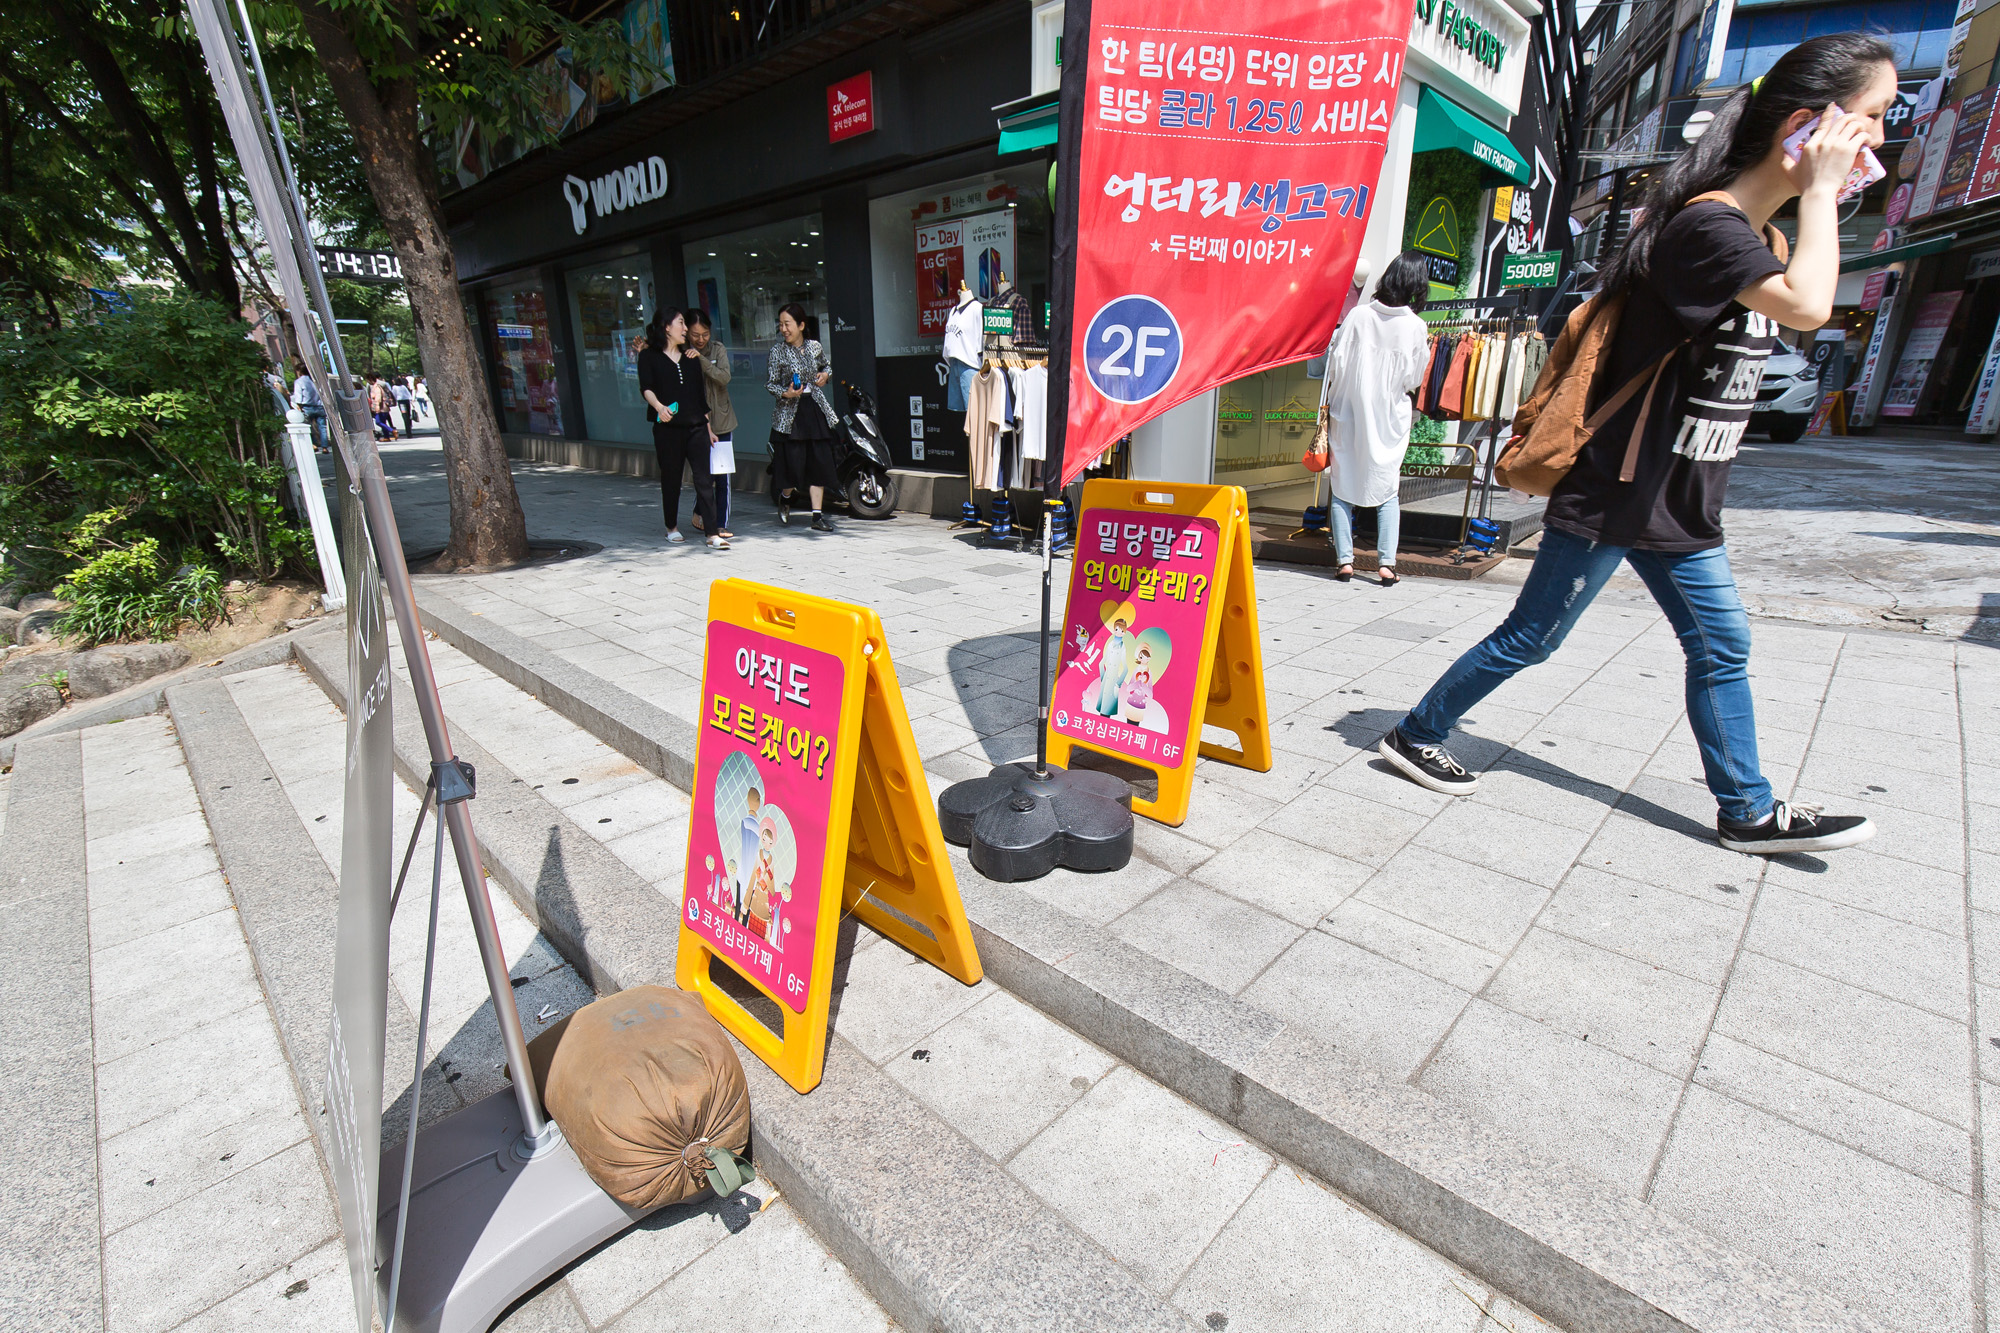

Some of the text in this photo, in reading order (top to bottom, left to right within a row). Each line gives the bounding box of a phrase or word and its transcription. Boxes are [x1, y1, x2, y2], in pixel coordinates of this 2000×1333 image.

[1441, 1, 1507, 73] FACTORY
[1101, 37, 1400, 91] 한 팀(4명) 단위 입장 시
[833, 98, 866, 117] SK telecom
[1099, 86, 1151, 125] 팀당
[1158, 88, 1217, 130] 콜라
[1311, 98, 1388, 134] 서비스
[1473, 139, 1518, 176] LUCKY FACTORY
[590, 156, 668, 217] WORLD
[923, 257, 935, 269] LG
[1167, 234, 1295, 265] 두번째 이야기
[1506, 262, 1556, 280] 5900원
[984, 316, 1011, 328] 12000원
[1099, 324, 1170, 377] 2F
[1265, 411, 1318, 420] LUCKY FACTORY
[1400, 465, 1450, 477] ACTORY
[1097, 520, 1204, 560] 밀당말고
[1083, 559, 1207, 604] 연애할래?
[735, 645, 811, 708] 아직도
[709, 695, 831, 780] 모르겠어?
[1071, 716, 1180, 759] 코칭심리카페 6F
[702, 909, 805, 999] 코칭심리카페 6F
